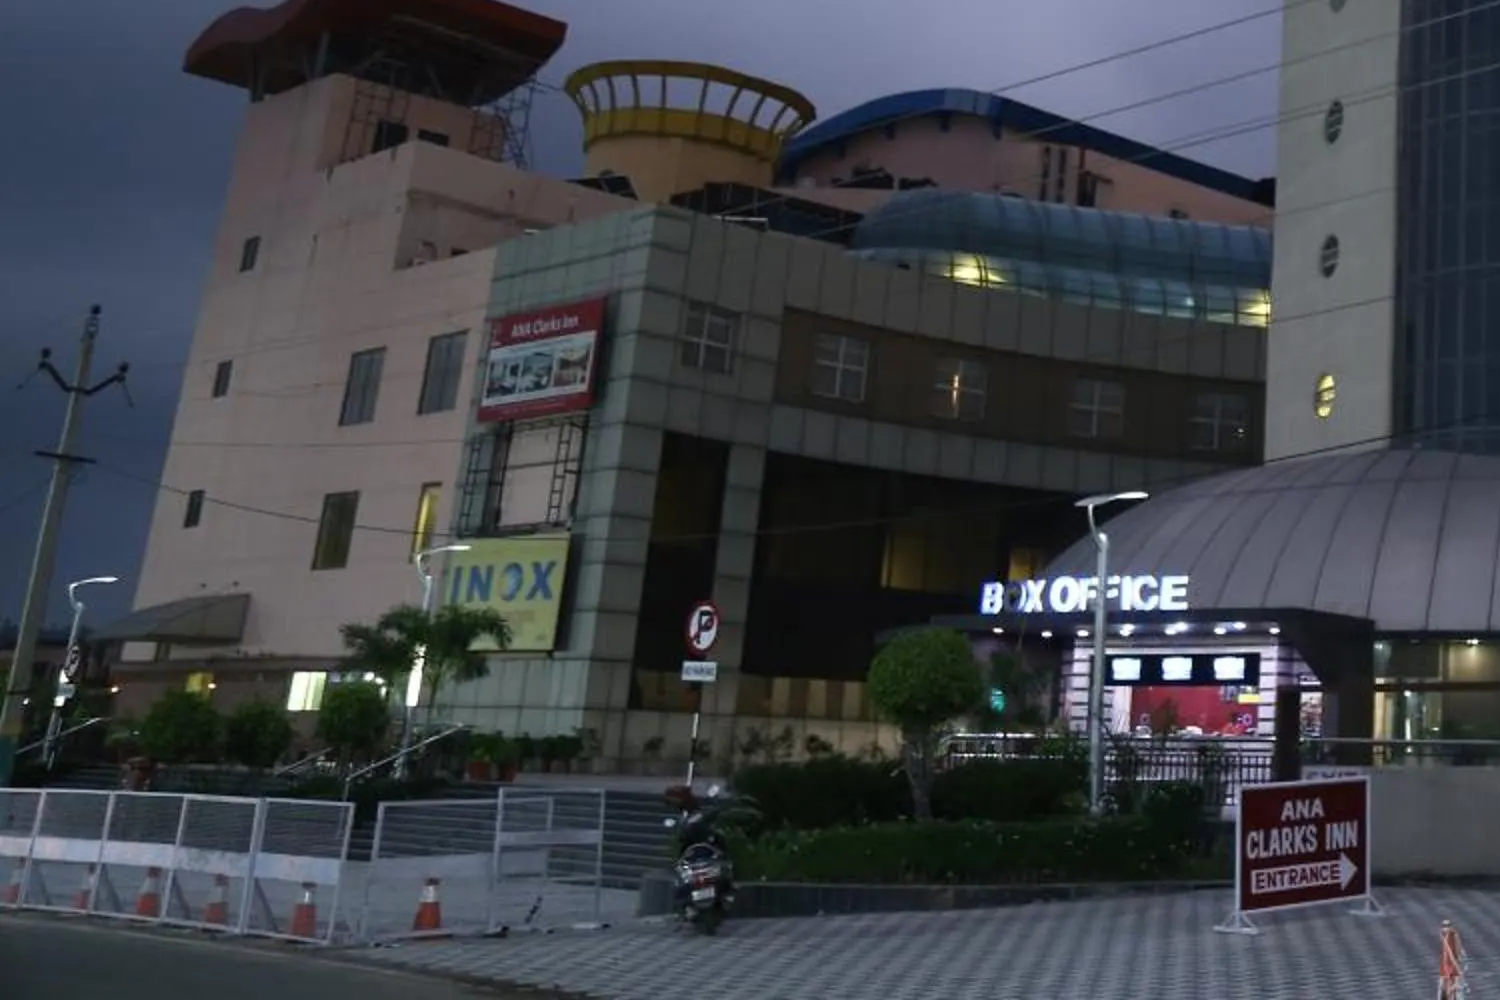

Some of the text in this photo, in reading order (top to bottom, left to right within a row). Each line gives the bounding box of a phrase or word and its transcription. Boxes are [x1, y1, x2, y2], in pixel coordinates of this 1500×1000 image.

[449, 561, 556, 605] INOX
[1281, 797, 1325, 821] ANA
[1246, 820, 1359, 859] CLARKS INN
[1254, 863, 1341, 890] ENTRANCE
